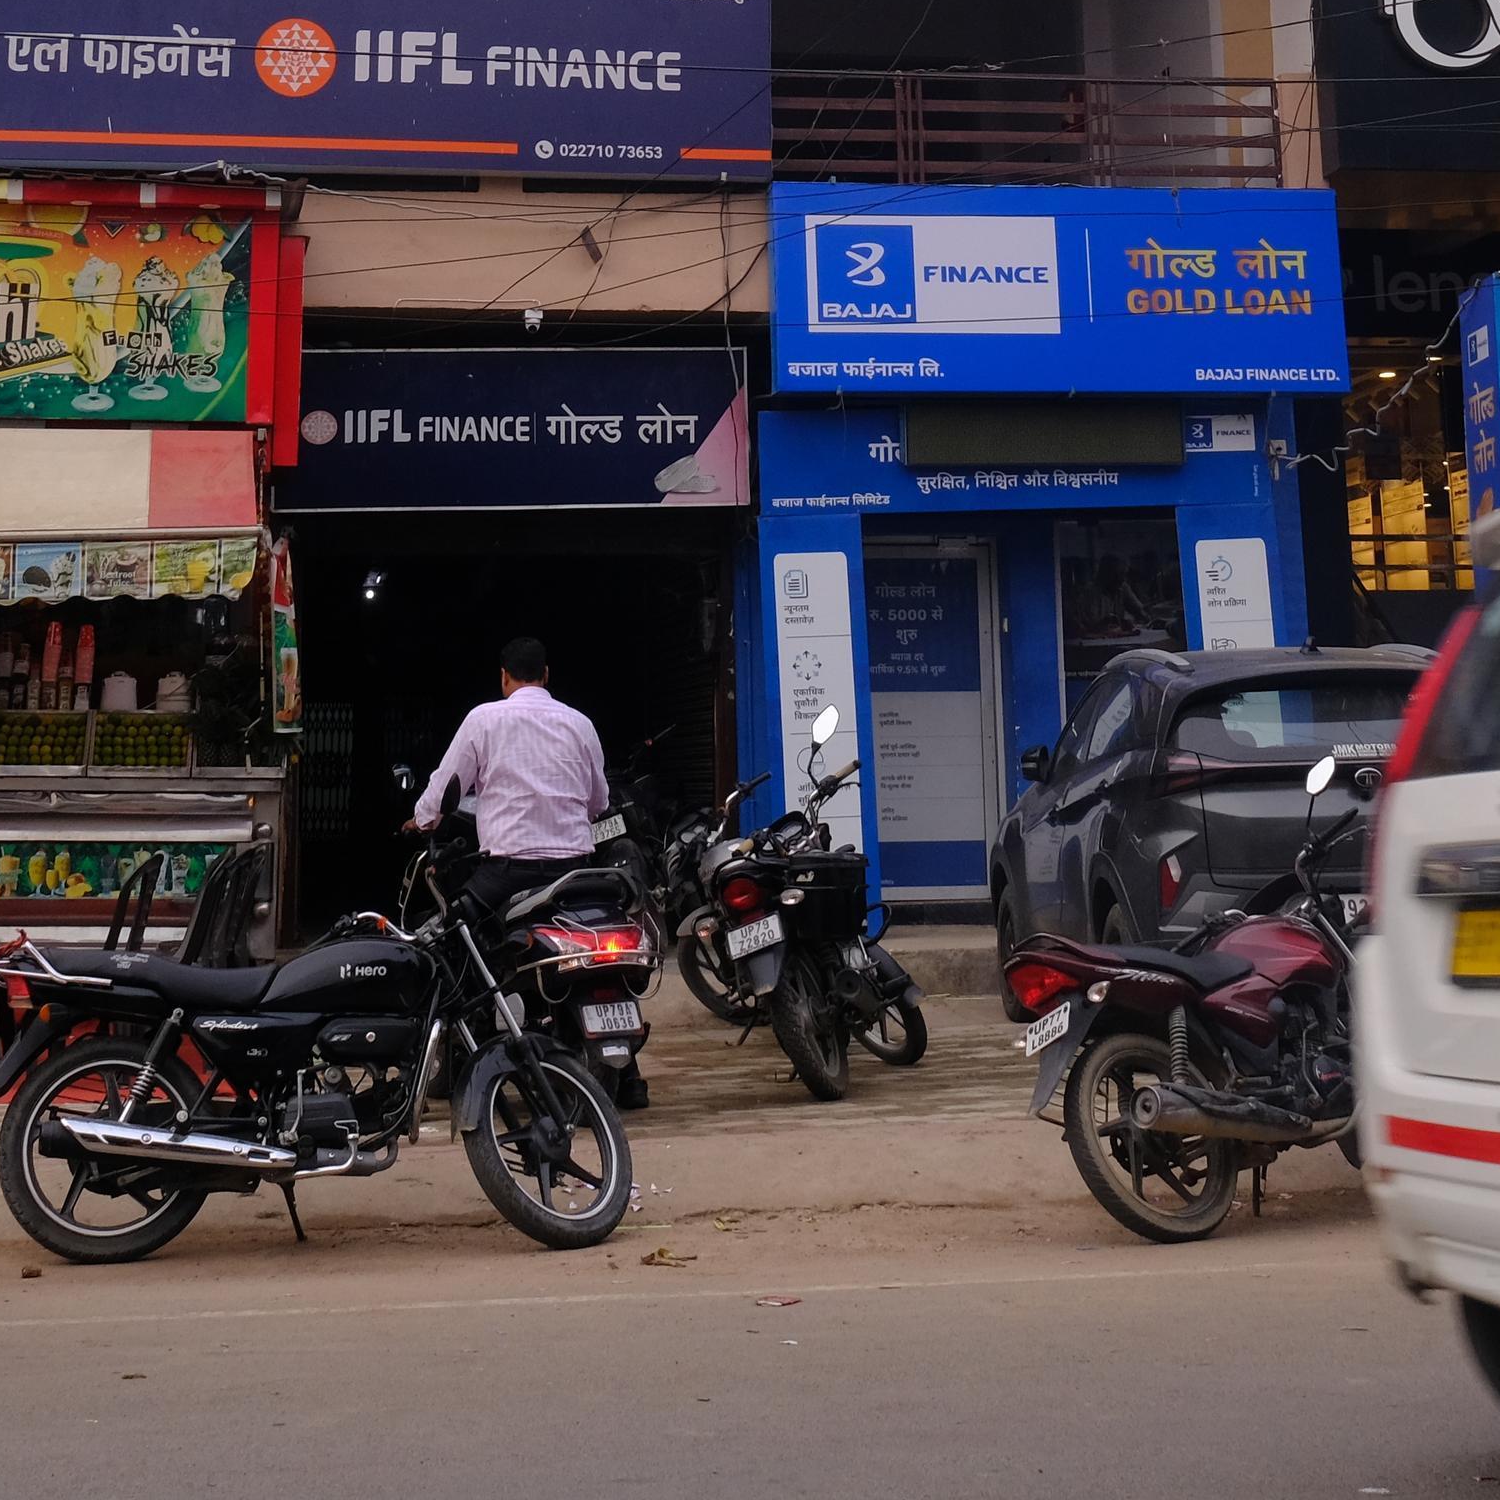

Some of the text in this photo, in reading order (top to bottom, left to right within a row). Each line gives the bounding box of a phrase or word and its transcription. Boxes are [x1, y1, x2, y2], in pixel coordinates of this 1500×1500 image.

[5, 31, 75, 74] एल
[80, 23, 236, 79] फाइनेंस
[354, 28, 682, 92] IIFL FINANCE
[559, 142, 664, 160] 022710 73653
[1125, 237, 1308, 281] गोल्ड लोन
[821, 265, 1049, 319] BAJAJ FINANCE
[1126, 289, 1312, 316] GOLD LOAN
[7, 336, 70, 364] Shakes
[123, 351, 220, 381] SHAKES
[788, 362, 838, 377] बजाज
[842, 357, 914, 380] फाईनान्स
[1195, 368, 1341, 382] BAJAJ FINANCE LTD.
[344, 409, 530, 444] IIFL FINANCE
[546, 403, 698, 445] गोल्ड लोन
[1215, 429, 1252, 437] FINANCE
[1023, 469, 1049, 488] और
[772, 497, 803, 509] बजाज
[910, 581, 937, 598] लोन
[888, 608, 927, 621] 5000
[1033, 1009, 1063, 1036] UP77
